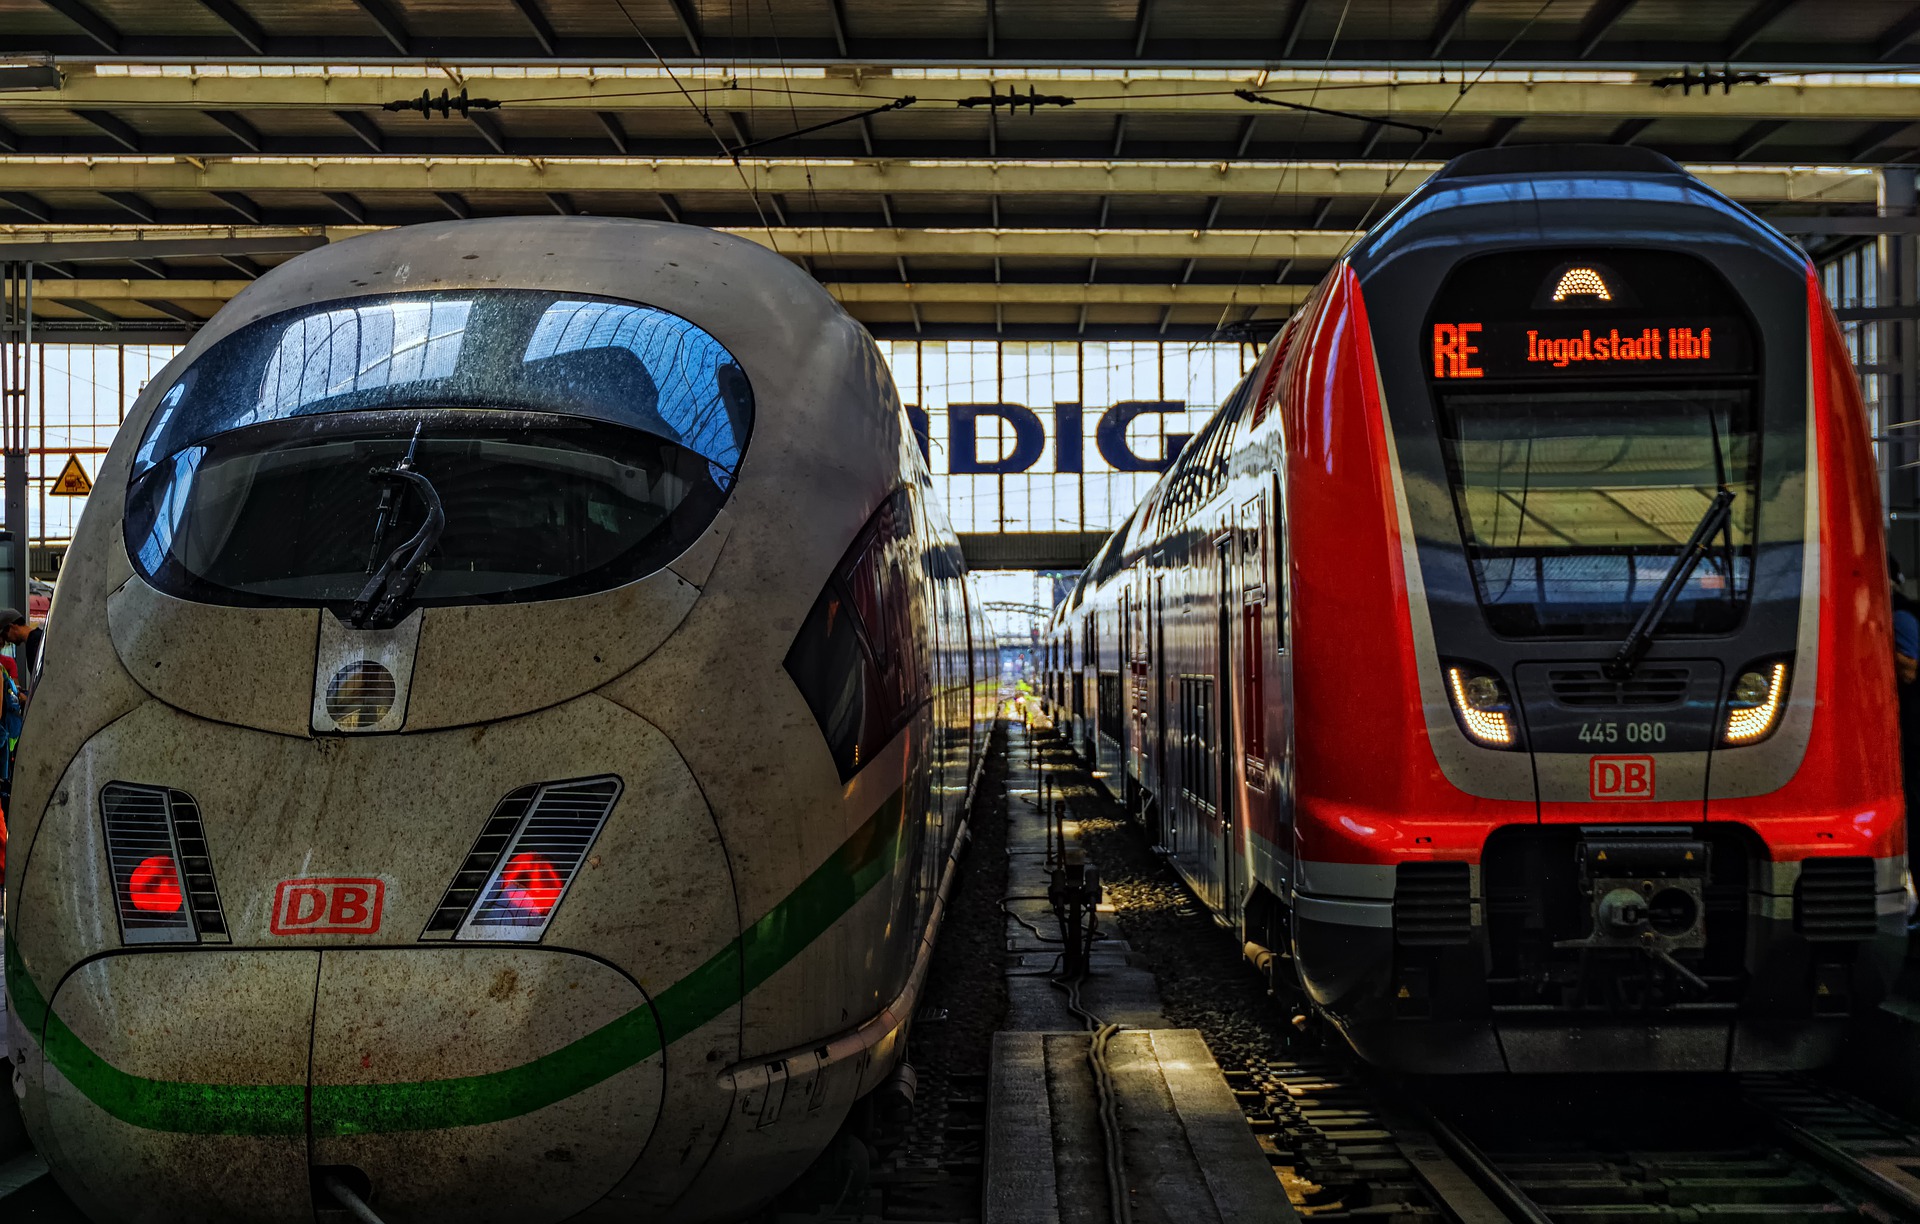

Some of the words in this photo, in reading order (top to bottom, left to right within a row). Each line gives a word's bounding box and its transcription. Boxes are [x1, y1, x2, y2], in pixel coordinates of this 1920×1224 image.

[1433, 322, 1484, 378] RE
[1527, 328, 1662, 367] Ingolstadt
[1667, 327, 1712, 359] Hbf
[1578, 722, 1618, 743] 445
[1626, 722, 1666, 742] 080
[1598, 763, 1647, 793] DB
[285, 887, 369, 925] DB
